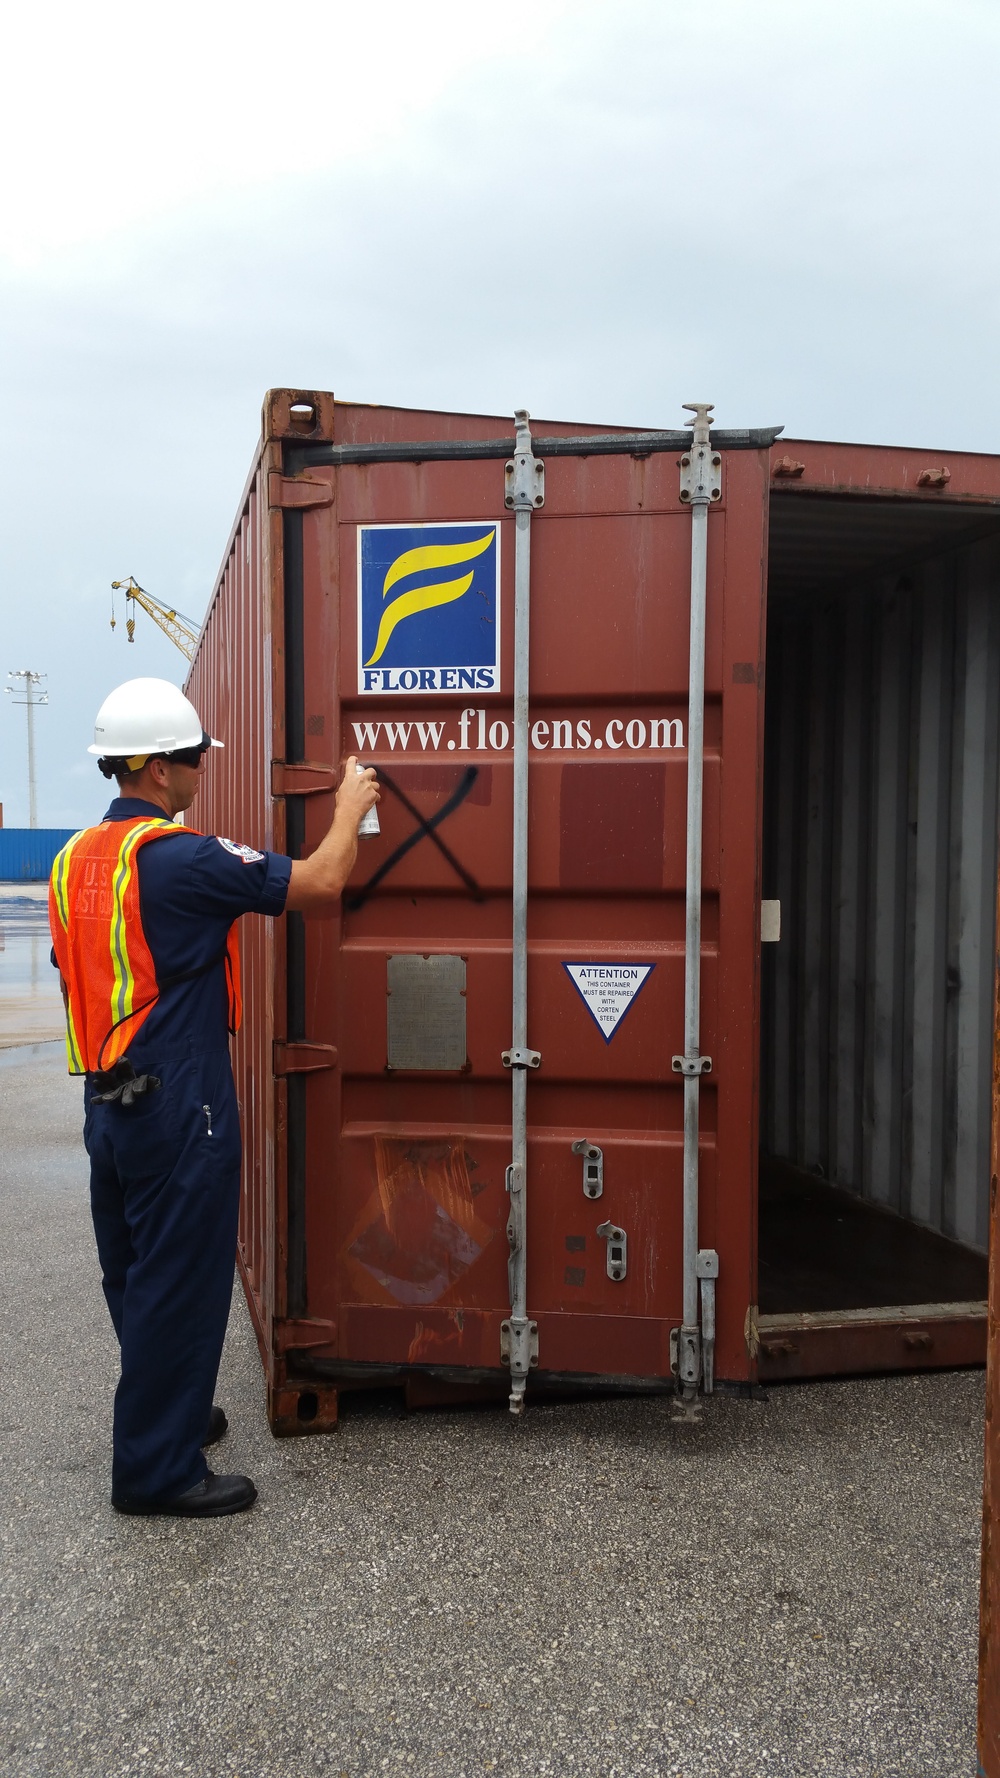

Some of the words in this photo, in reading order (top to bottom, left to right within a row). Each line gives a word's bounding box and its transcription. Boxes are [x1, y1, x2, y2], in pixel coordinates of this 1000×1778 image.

[363, 668, 495, 691] FLORENS
[350, 708, 685, 751] www.floens.com
[579, 969, 638, 979] ATTENTION
